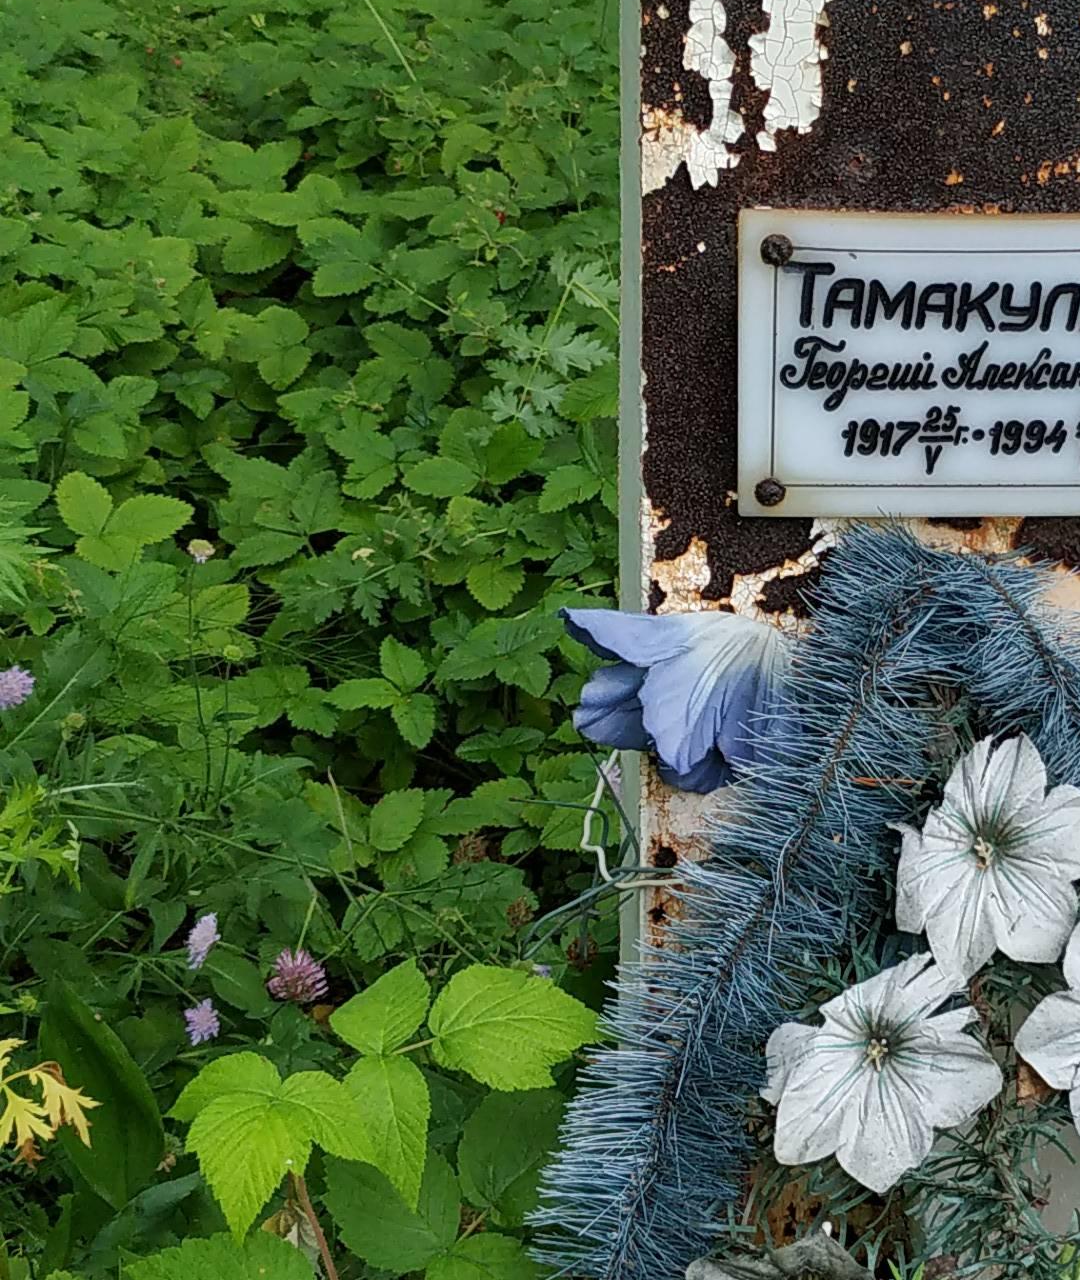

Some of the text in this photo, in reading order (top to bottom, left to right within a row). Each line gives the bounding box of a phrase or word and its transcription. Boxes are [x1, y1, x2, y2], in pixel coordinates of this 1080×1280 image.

[780, 336, 937, 412] Георгий
[842, 418, 920, 457] 1917
[989, 419, 1067, 456] 1994
